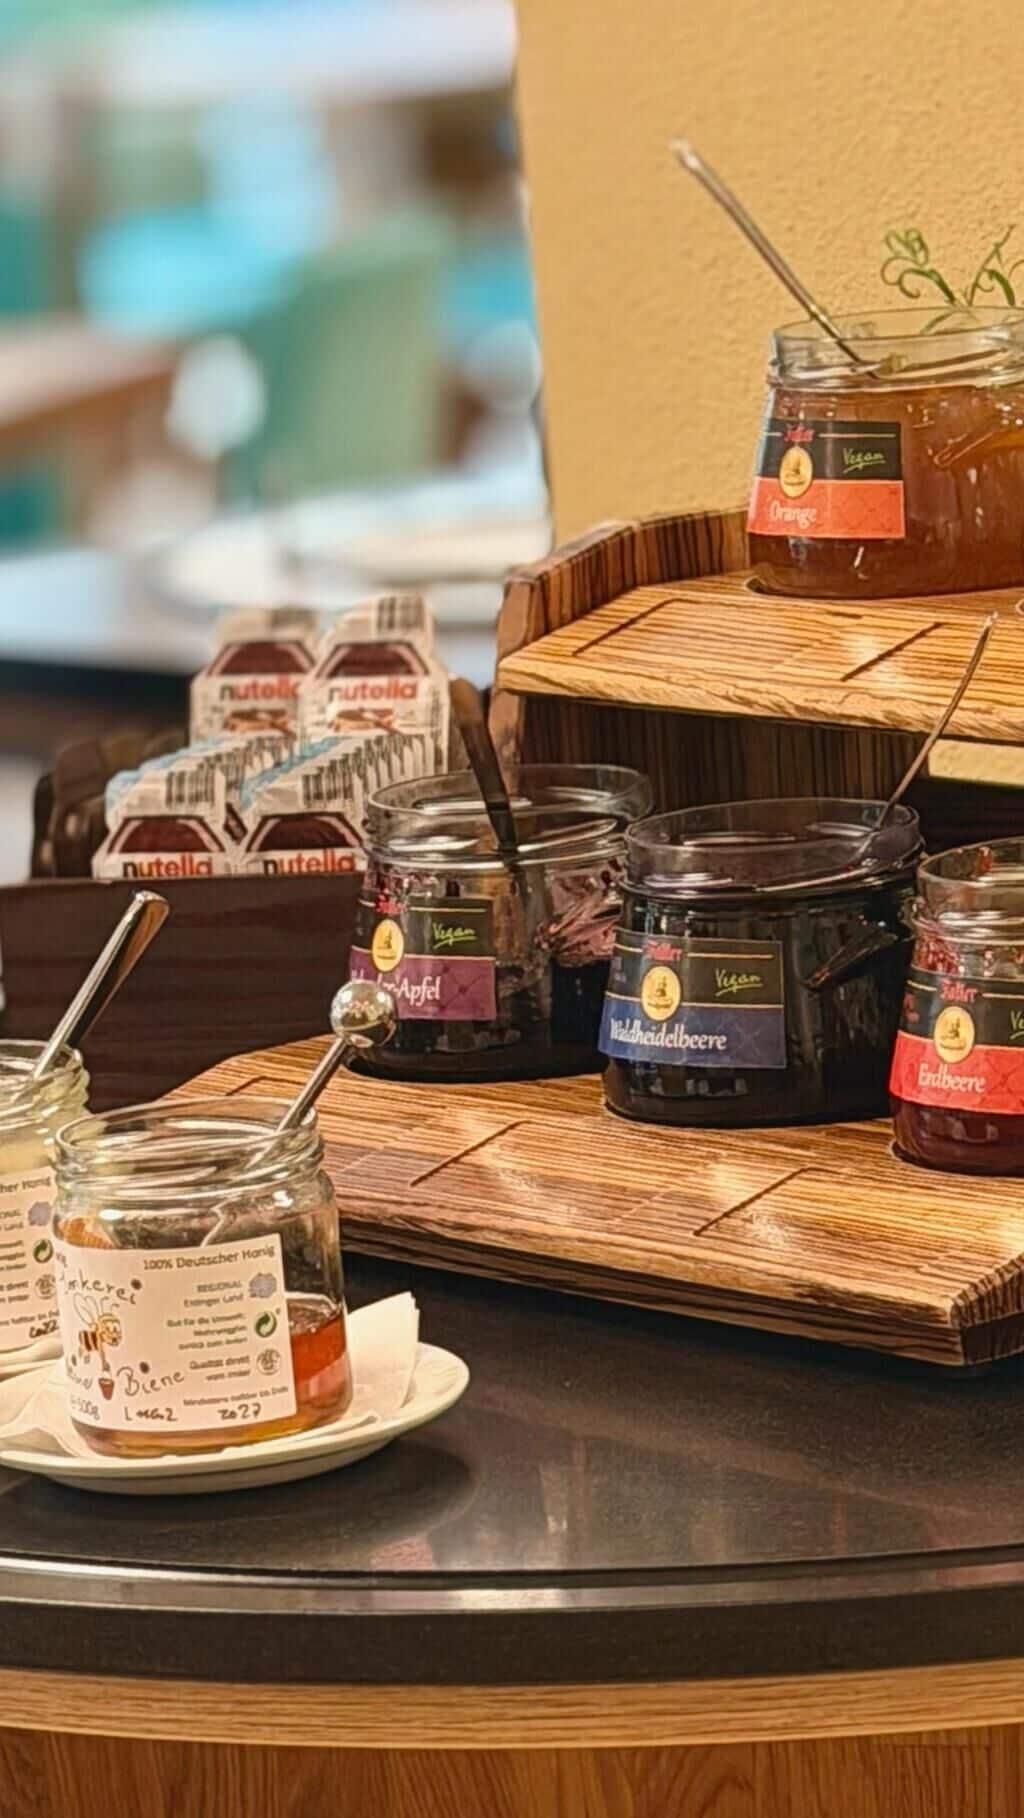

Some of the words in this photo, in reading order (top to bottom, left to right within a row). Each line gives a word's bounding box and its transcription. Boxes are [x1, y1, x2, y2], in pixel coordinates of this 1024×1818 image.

[842, 448, 885, 471] Vegan
[770, 501, 817, 529] Orange
[330, 679, 417, 700] nutella
[122, 852, 213, 877] nutella
[263, 849, 356, 875] nutella
[432, 922, 476, 946] Vegan
[715, 968, 762, 993] Vegan
[610, 1018, 727, 1050] Waldheidelbeere
[918, 1063, 985, 1093] Erdbeere
[143, 1259, 173, 1271] 100%
[176, 1252, 238, 1269] Deutscher
[242, 1246, 276, 1260] Honig
[116, 1362, 185, 1397] Biene
